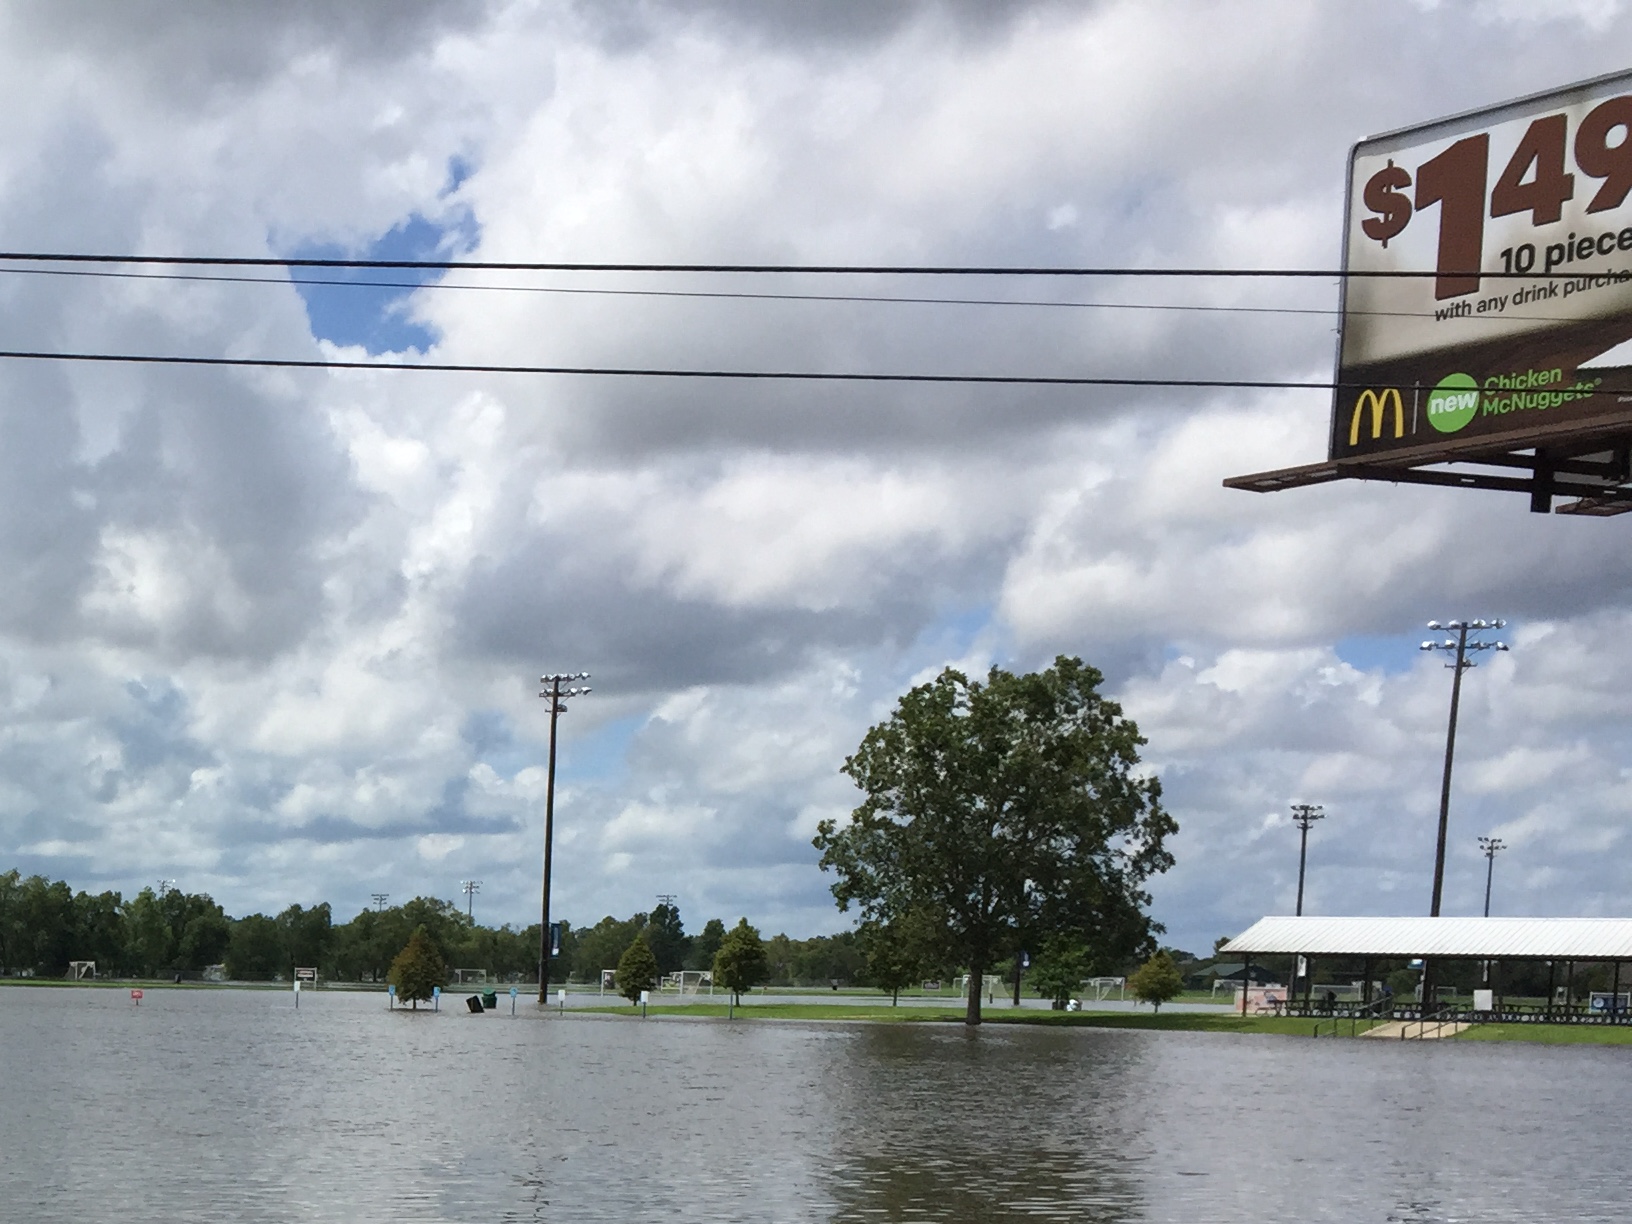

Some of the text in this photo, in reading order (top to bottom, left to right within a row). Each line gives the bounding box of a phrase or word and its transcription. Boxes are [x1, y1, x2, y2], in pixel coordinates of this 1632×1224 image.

[1500, 225, 1632, 278] 10 piece
[1435, 302, 1472, 322] with
[1476, 293, 1509, 313] any
[1512, 281, 1559, 305] drink
[1482, 381, 1595, 417] McNuggets
[1484, 368, 1563, 396] Chicken
[1430, 391, 1478, 415] new
